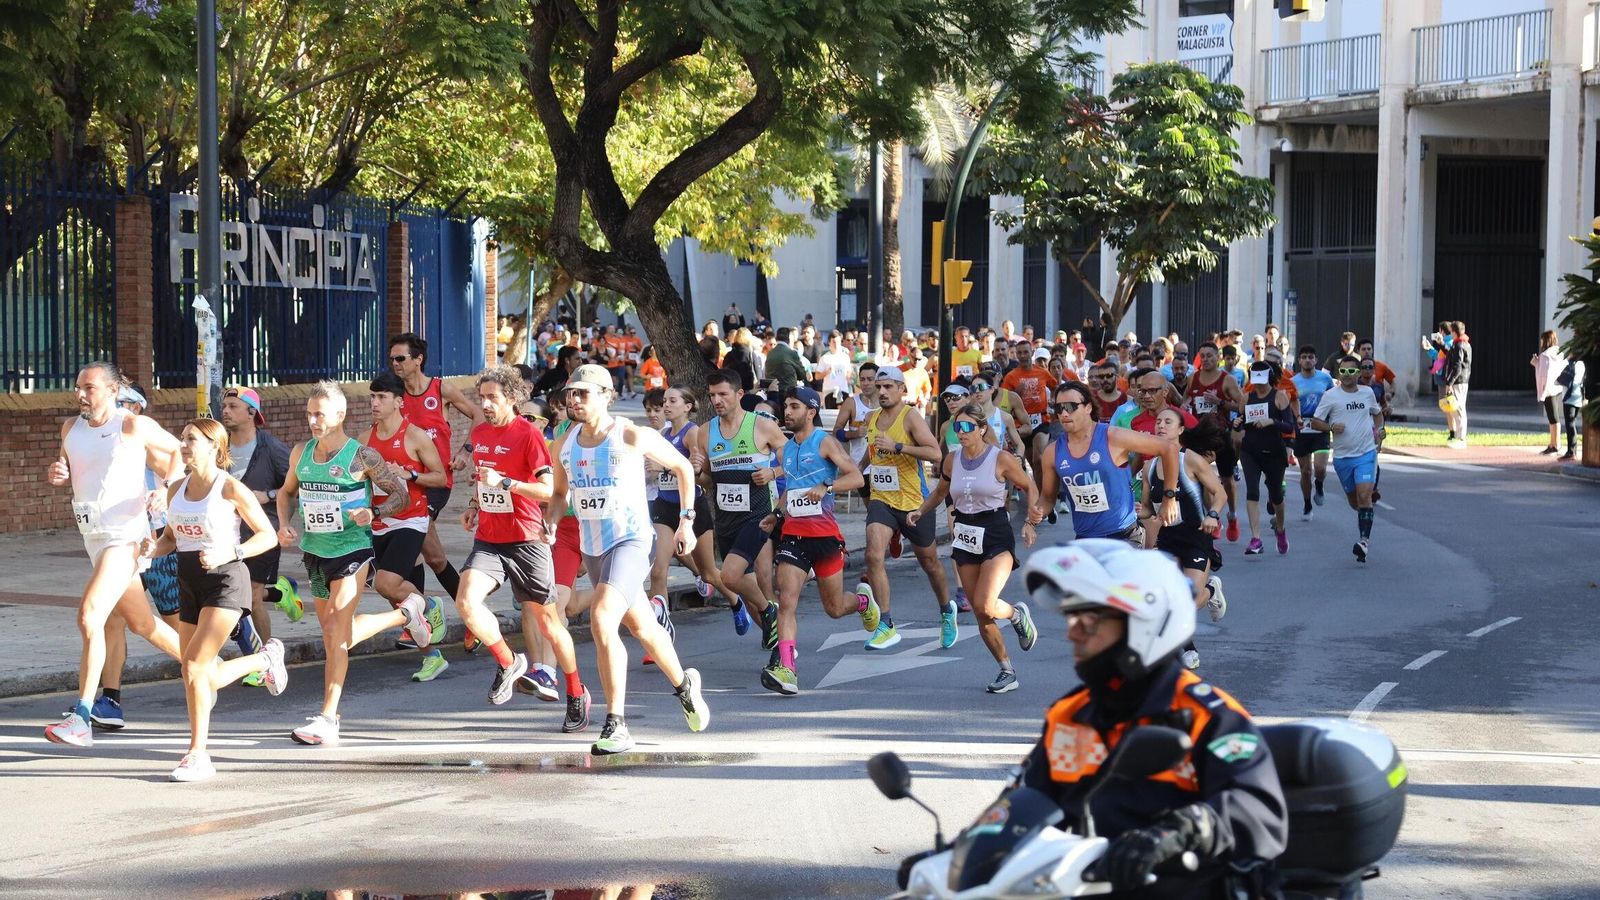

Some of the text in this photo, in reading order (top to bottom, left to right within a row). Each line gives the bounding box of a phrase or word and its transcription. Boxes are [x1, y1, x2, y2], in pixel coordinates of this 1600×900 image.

[1177, 23, 1226, 38] CORNER VIP
[1177, 36, 1225, 50] MALAGUISTA
[1346, 401, 1365, 410] nike
[1249, 409, 1265, 417] 558
[874, 474, 892, 483] 950
[302, 482, 340, 492] ATLETISMO
[482, 492, 505, 504] 573
[581, 498, 606, 509] 947
[721, 493, 743, 503] 754
[1076, 494, 1099, 505] 752
[308, 512, 335, 524] 365
[176, 525, 203, 536] 453
[957, 533, 977, 546] 464
